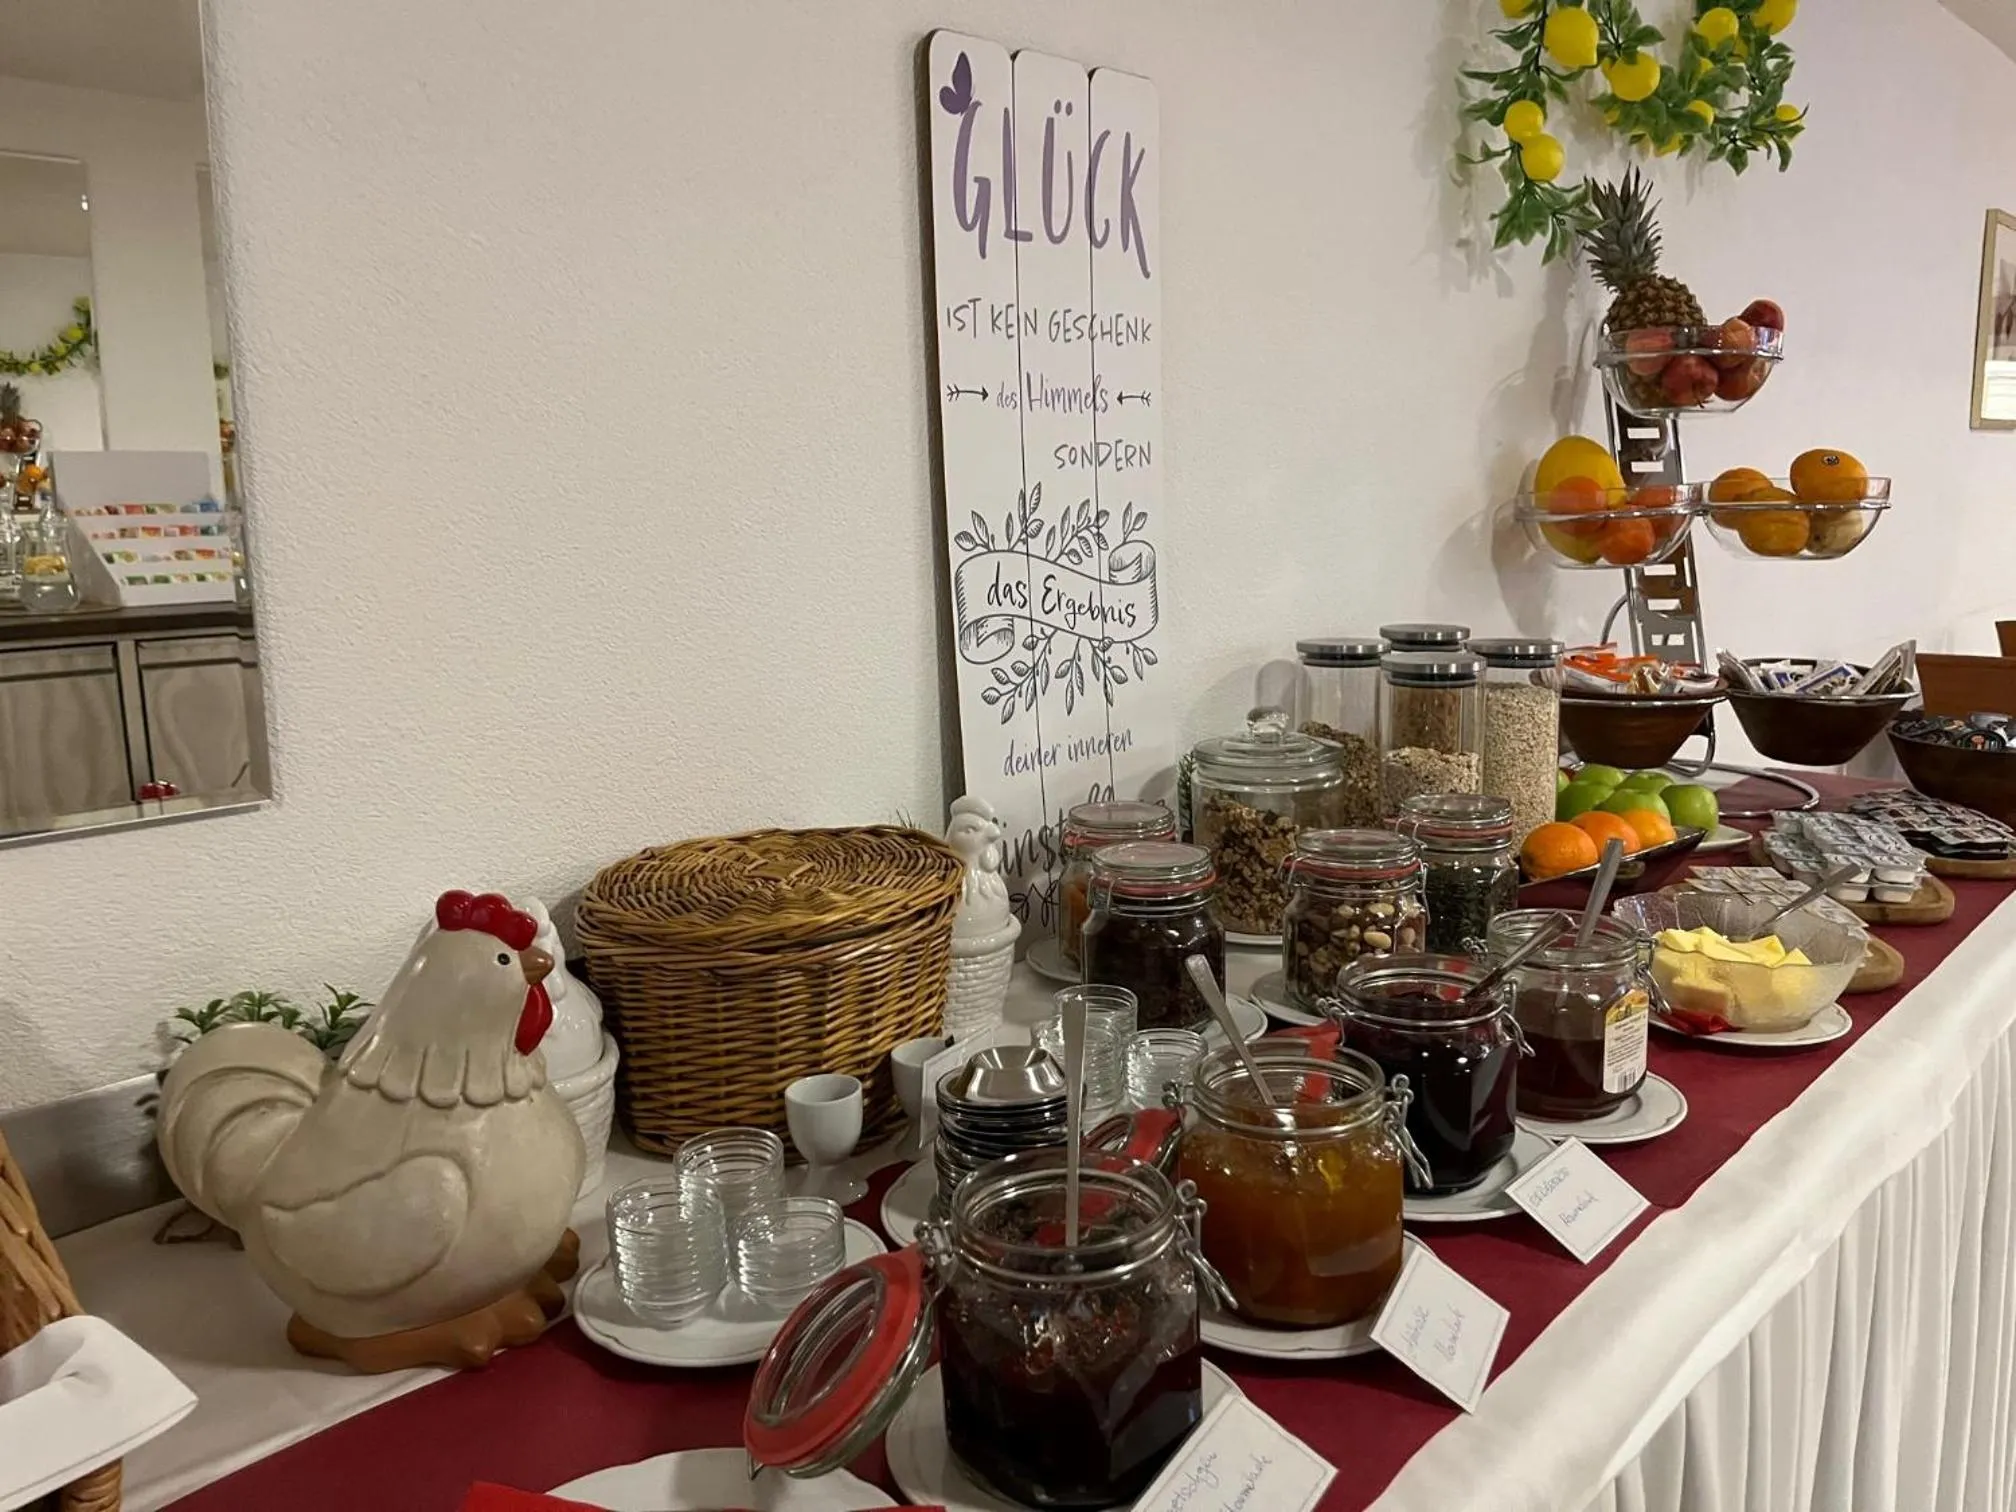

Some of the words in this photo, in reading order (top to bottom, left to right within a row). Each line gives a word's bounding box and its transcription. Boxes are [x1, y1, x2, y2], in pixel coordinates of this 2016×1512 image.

[953, 99, 1150, 279] GLÜCK
[946, 298, 982, 339] IST
[991, 304, 1038, 341] KEIN
[1048, 308, 1152, 346] GESCHENK
[996, 380, 1018, 410] des
[1026, 371, 1109, 415] Himmels
[1054, 440, 1151, 471] SONDERN
[987, 561, 1028, 607] das
[1042, 574, 1137, 629] Ergebnis
[1003, 738, 1062, 777] deiner
[1067, 727, 1133, 764] inneren
